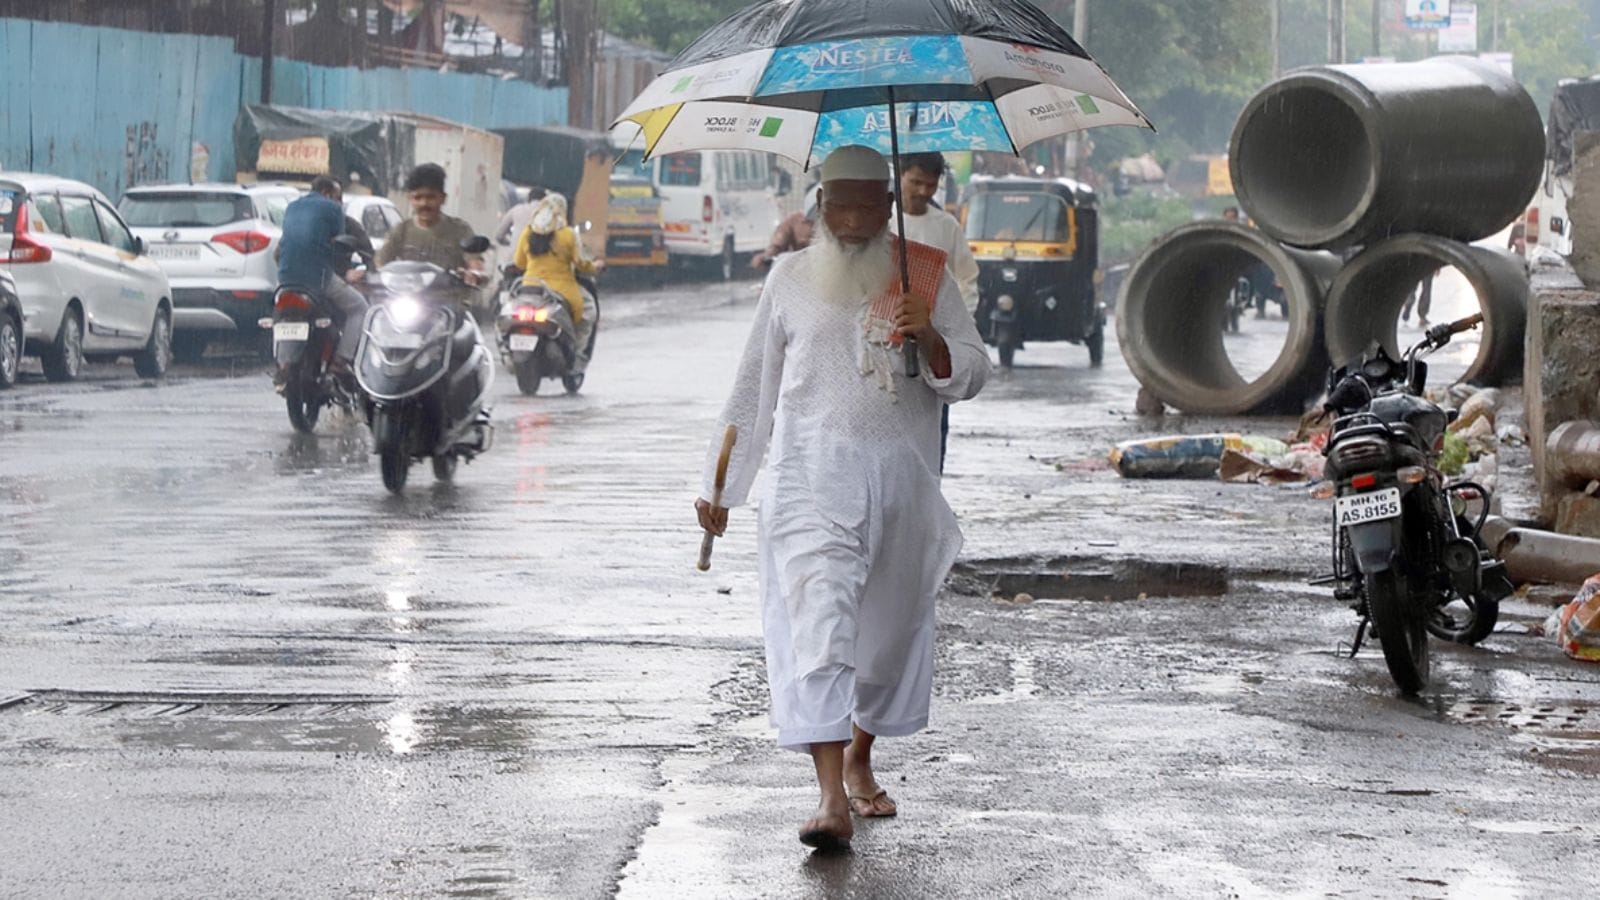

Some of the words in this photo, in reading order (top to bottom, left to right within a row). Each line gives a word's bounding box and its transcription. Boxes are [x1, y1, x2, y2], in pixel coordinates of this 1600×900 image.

[818, 47, 917, 66] NESTEA
[1004, 51, 1066, 74] Amanora
[1342, 502, 1397, 523] AS.8155
